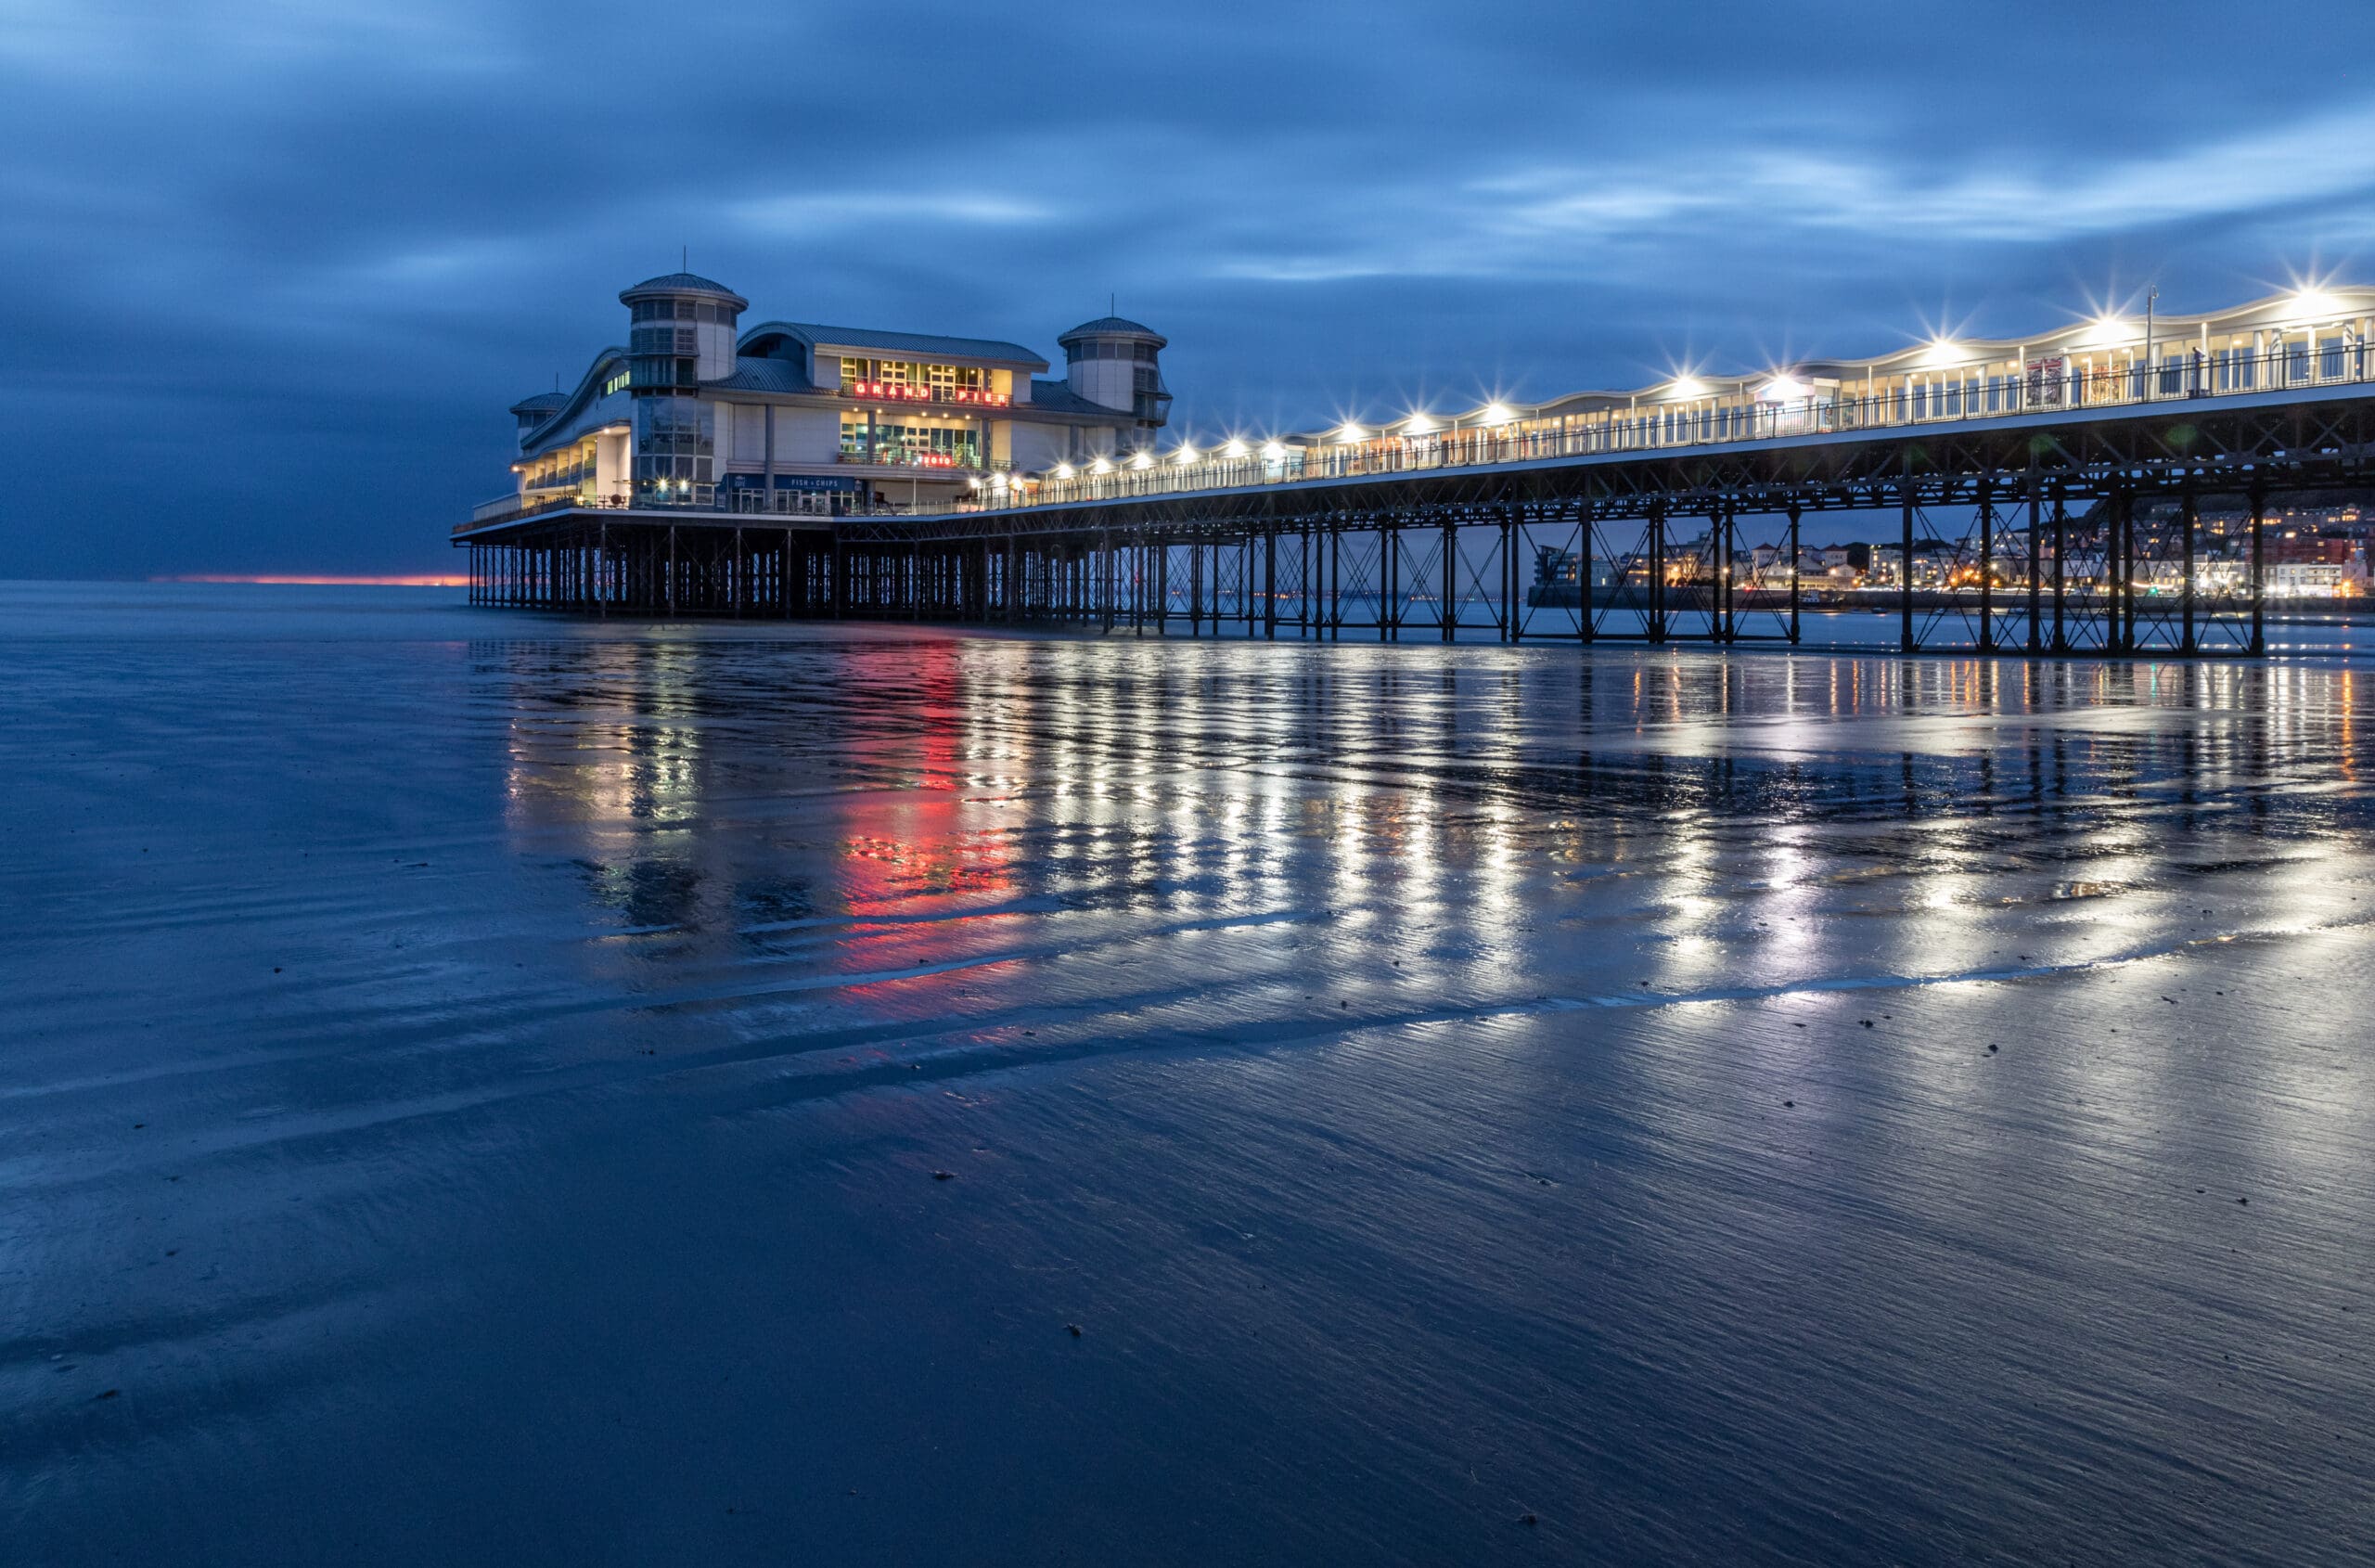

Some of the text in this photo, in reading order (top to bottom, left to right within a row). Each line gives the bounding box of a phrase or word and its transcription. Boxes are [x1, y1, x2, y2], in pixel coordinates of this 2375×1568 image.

[855, 383, 1006, 403] GRAND PIER
[924, 456, 950, 465] 2010
